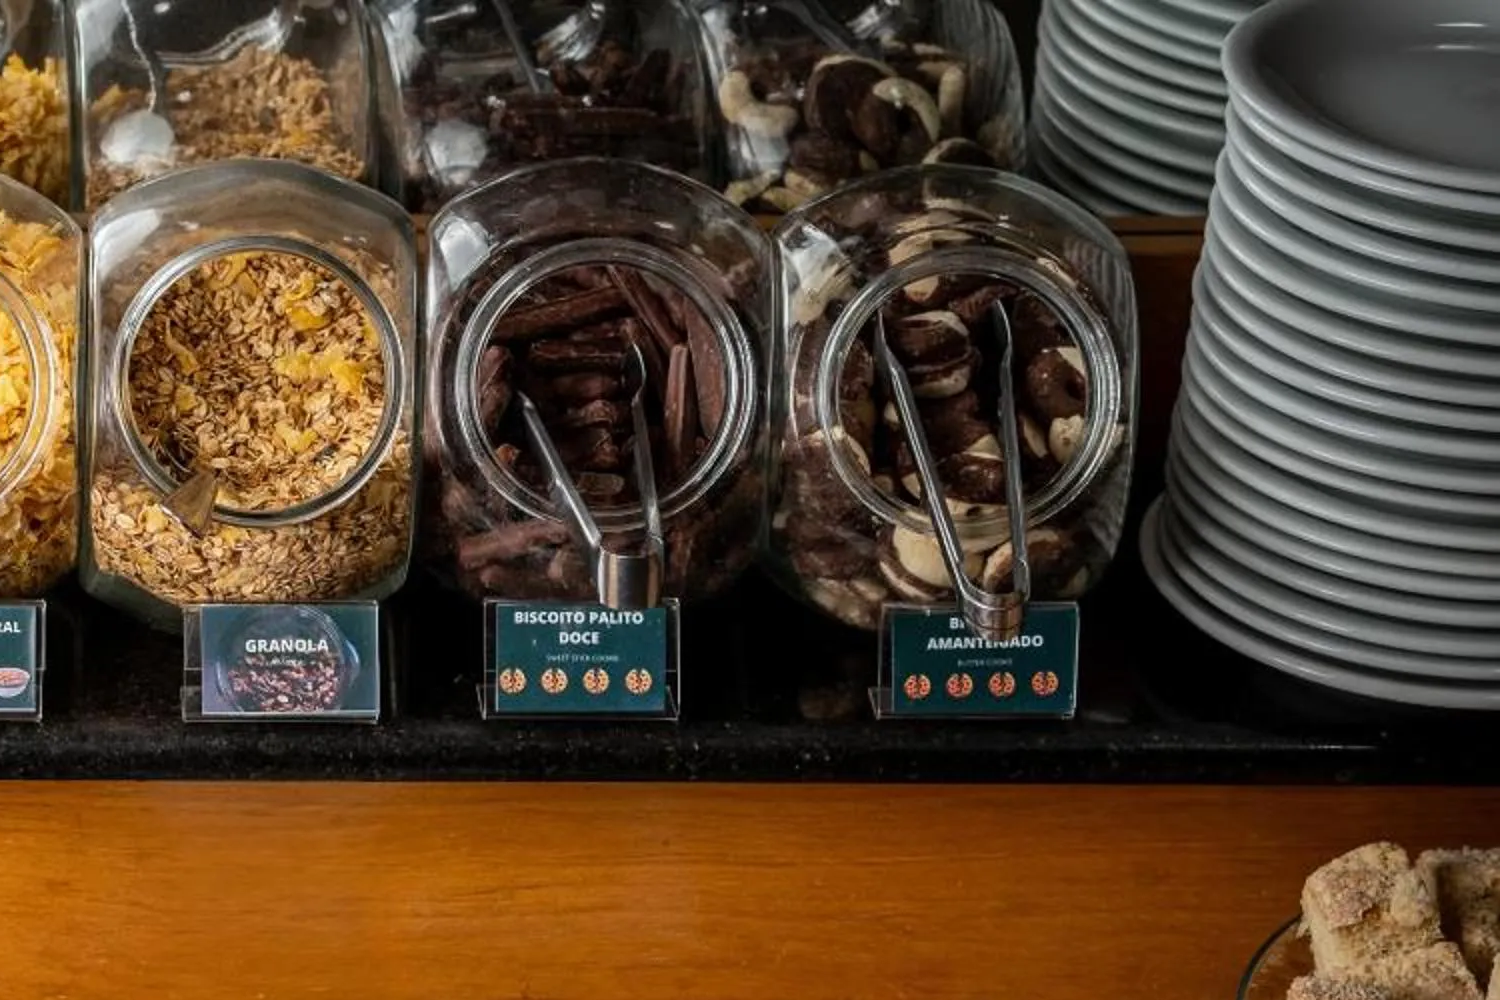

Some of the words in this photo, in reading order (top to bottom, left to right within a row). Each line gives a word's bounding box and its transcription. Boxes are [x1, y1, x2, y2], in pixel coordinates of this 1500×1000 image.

[514, 611, 585, 625] BISCOITO
[589, 611, 644, 625] PALITO
[559, 632, 601, 645] DOCE
[245, 639, 329, 653] GRANOLA
